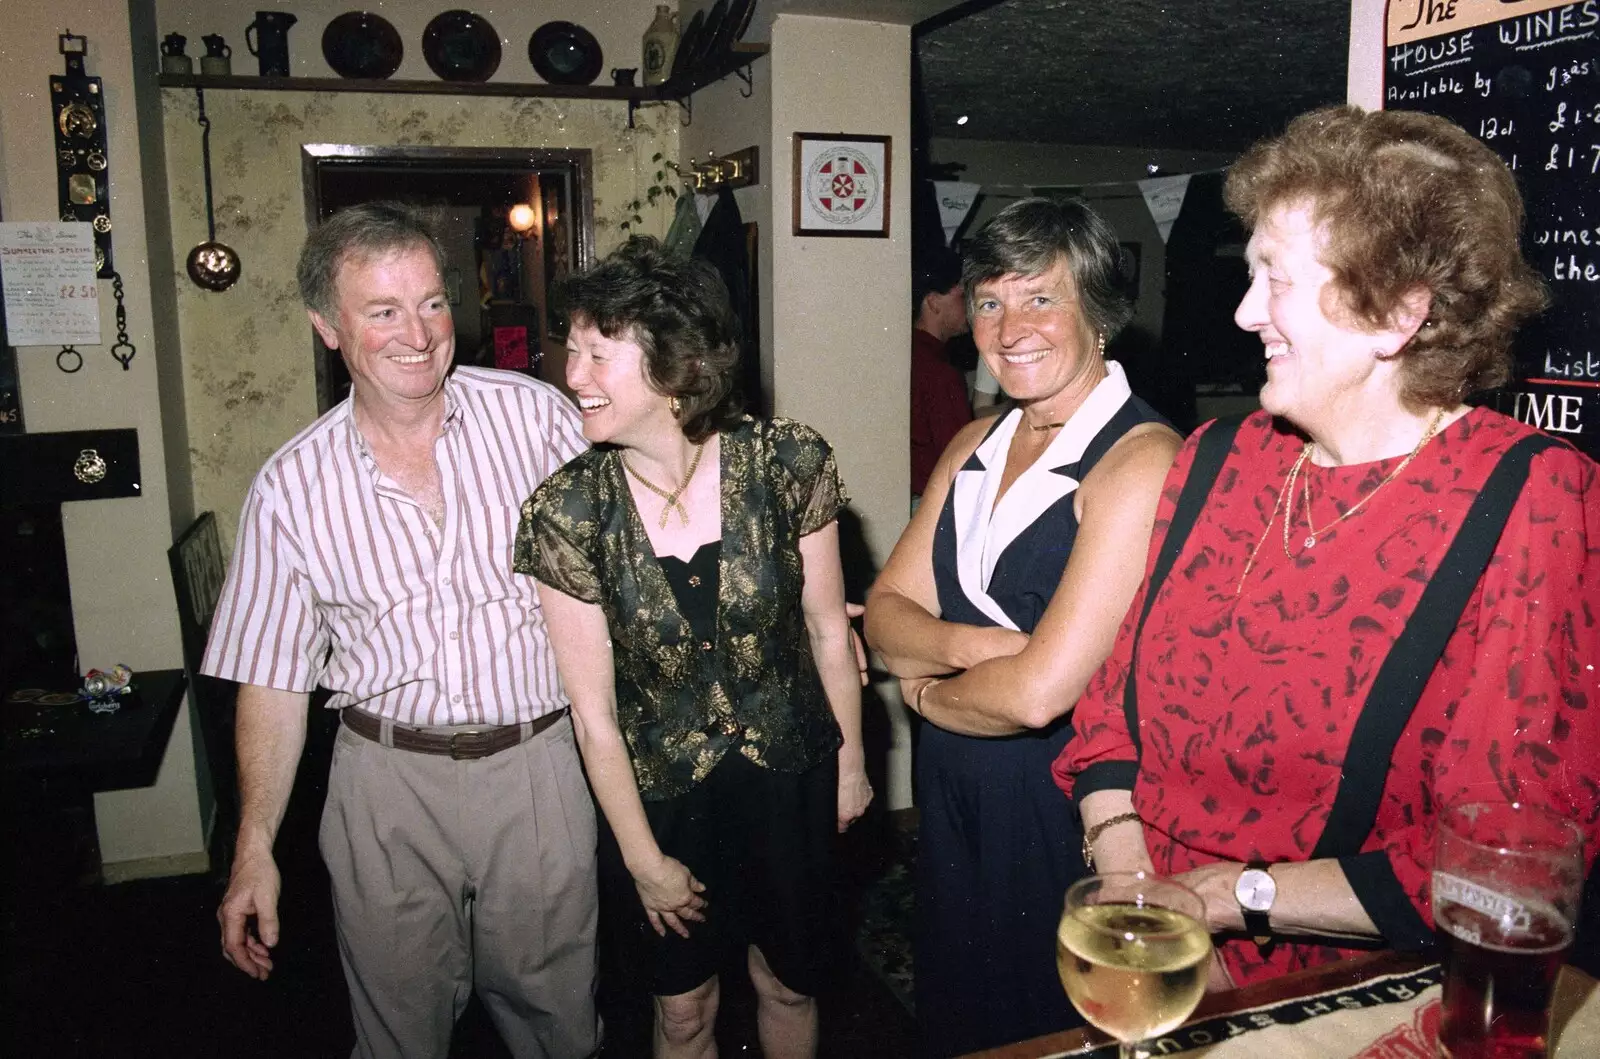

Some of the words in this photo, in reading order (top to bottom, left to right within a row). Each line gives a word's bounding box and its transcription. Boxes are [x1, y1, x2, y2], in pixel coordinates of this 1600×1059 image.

[1391, 30, 1475, 71] HOUSE
[1499, 1, 1600, 45] WINES
[1388, 77, 1465, 101] Available
[1474, 71, 1492, 97] by
[1554, 254, 1600, 282] the
[1544, 347, 1600, 377] List
[1507, 391, 1583, 434] IME
[1154, 1011, 1277, 1054] STOU
